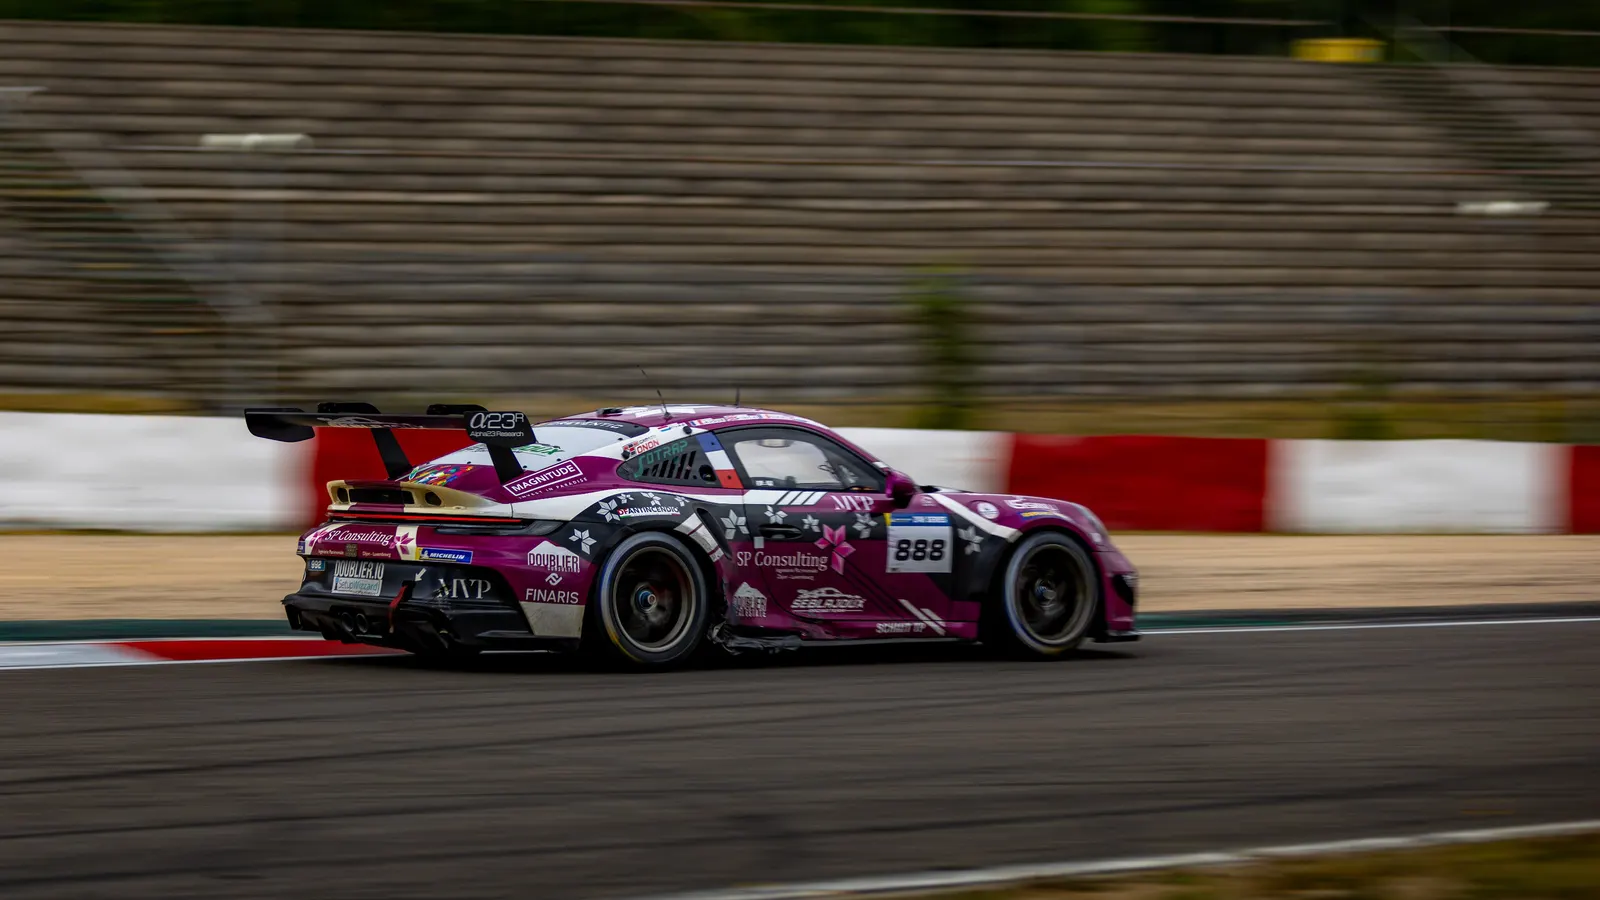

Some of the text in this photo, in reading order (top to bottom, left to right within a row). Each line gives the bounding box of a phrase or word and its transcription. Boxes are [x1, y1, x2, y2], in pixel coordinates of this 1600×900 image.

[511, 465, 576, 492] MAGNITUDE
[556, 477, 588, 489] PARADISE
[831, 495, 874, 511] MVP
[325, 530, 394, 546] SP Consulting
[429, 552, 466, 560] MICHELIN
[895, 539, 945, 561] 888
[528, 553, 580, 571] DOUBLIER
[737, 551, 829, 571] SP Consulting
[334, 560, 384, 580] DOUBLIER.IO
[525, 588, 579, 604] FINARIS
